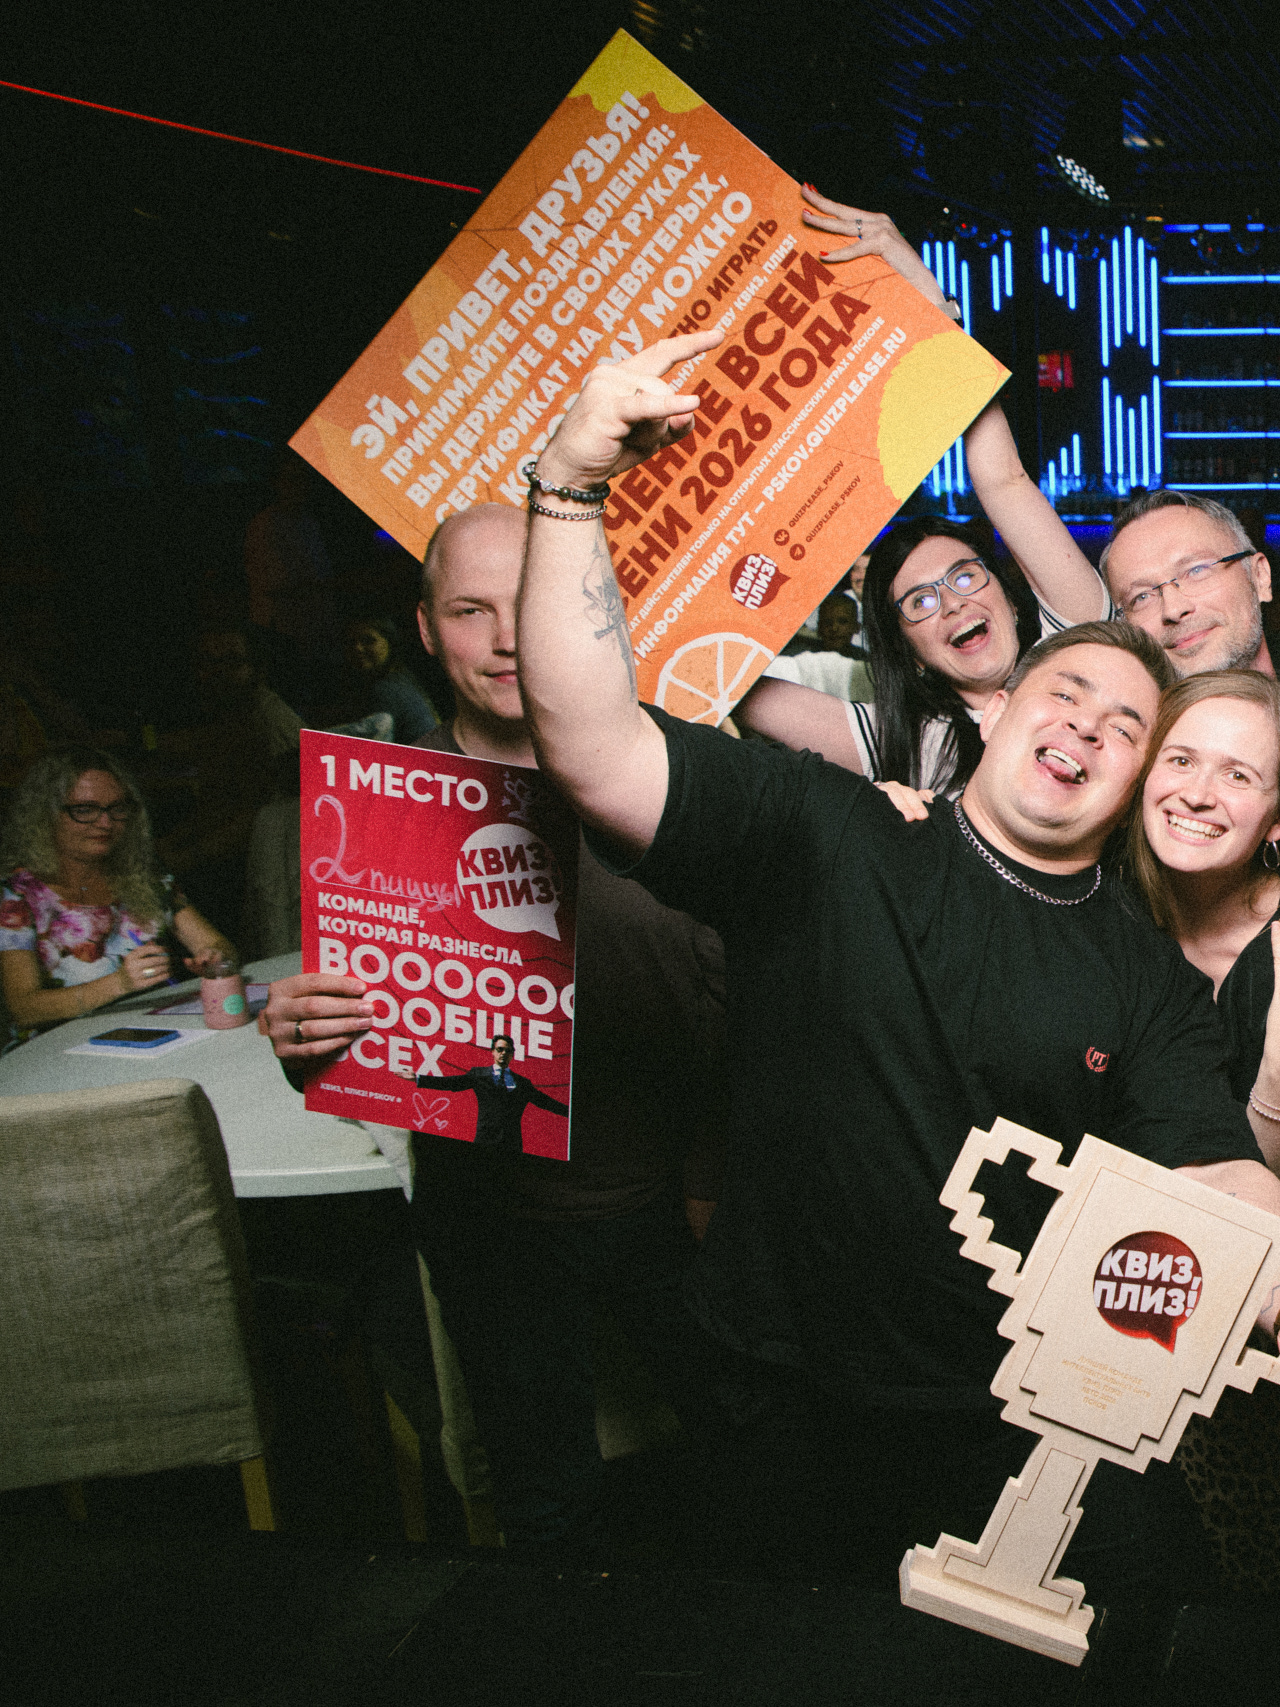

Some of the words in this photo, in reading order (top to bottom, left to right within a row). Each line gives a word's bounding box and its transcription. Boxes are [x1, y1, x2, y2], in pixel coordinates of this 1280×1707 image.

[351, 394, 420, 459] ЭЙ,
[403, 249, 533, 395] ПРИВЕТ,
[519, 92, 649, 257] ДРУЗЬЯ!
[562, 327, 603, 367] НА
[594, 173, 728, 333] ДЕВЯТЕРЫХ,
[639, 192, 752, 328] МОЖНО
[707, 220, 777, 301] ИГРАТЬ
[734, 276, 768, 310] КВИЗ,
[762, 234, 797, 274] ПЛИЗ!
[381, 319, 519, 485] ПРИНИМАЙТЕ
[509, 125, 675, 325] ПОЗДРАВЛЕНИЯ:
[406, 460, 450, 508] ВЫ
[441, 343, 543, 470] ДЕРЖИТЕ
[533, 324, 557, 349] В
[552, 230, 631, 326] СВОИХ
[621, 143, 701, 236] РУКАХ
[851, 316, 885, 354] ПСКОВЕ
[823, 358, 850, 389] ИГРАХ
[846, 350, 857, 361] В
[603, 379, 732, 555] ЧЕНИЕ
[716, 250, 834, 390] ВСЕЙ
[767, 386, 827, 458] КЛАССИЧЕСКИХ
[616, 505, 692, 607] ЕНИ
[680, 405, 771, 514] 2026
[760, 292, 870, 411] ГОДА
[728, 455, 771, 506] ОТКРЫТЫХ
[634, 542, 732, 658] ИНФОРМАЦИЯ
[725, 511, 755, 545] ТУТ
[762, 326, 907, 502] PSKOV.QUIZPLEASE.RU
[717, 505, 732, 520] НА
[790, 464, 842, 526] QUIZPLEASE_PSKOV
[807, 479, 859, 542] QUIZPLEASE_PSKOV
[689, 518, 721, 553] ТОЛЬКО
[638, 552, 693, 620] ДЕЙСТВИТЕЛЕН
[744, 557, 777, 610] ПЛИЗ!
[320, 754, 336, 787] 1
[350, 758, 488, 812] МЕСТО
[309, 794, 367, 885] 2
[318, 892, 426, 928] КОМАНДЕ,
[318, 915, 413, 946] КОТОРАЯ
[418, 932, 523, 967] РАЗНЕСЛА
[336, 1031, 447, 1077] СЕХ
[363, 990, 553, 1062] ООБЩЕ
[1091, 1051, 1107, 1065] PT
[369, 1091, 396, 1102] PSKOV
[1094, 1280, 1198, 1318] ПЛИЗ!
[1100, 1249, 1202, 1290] КВИЗ,
